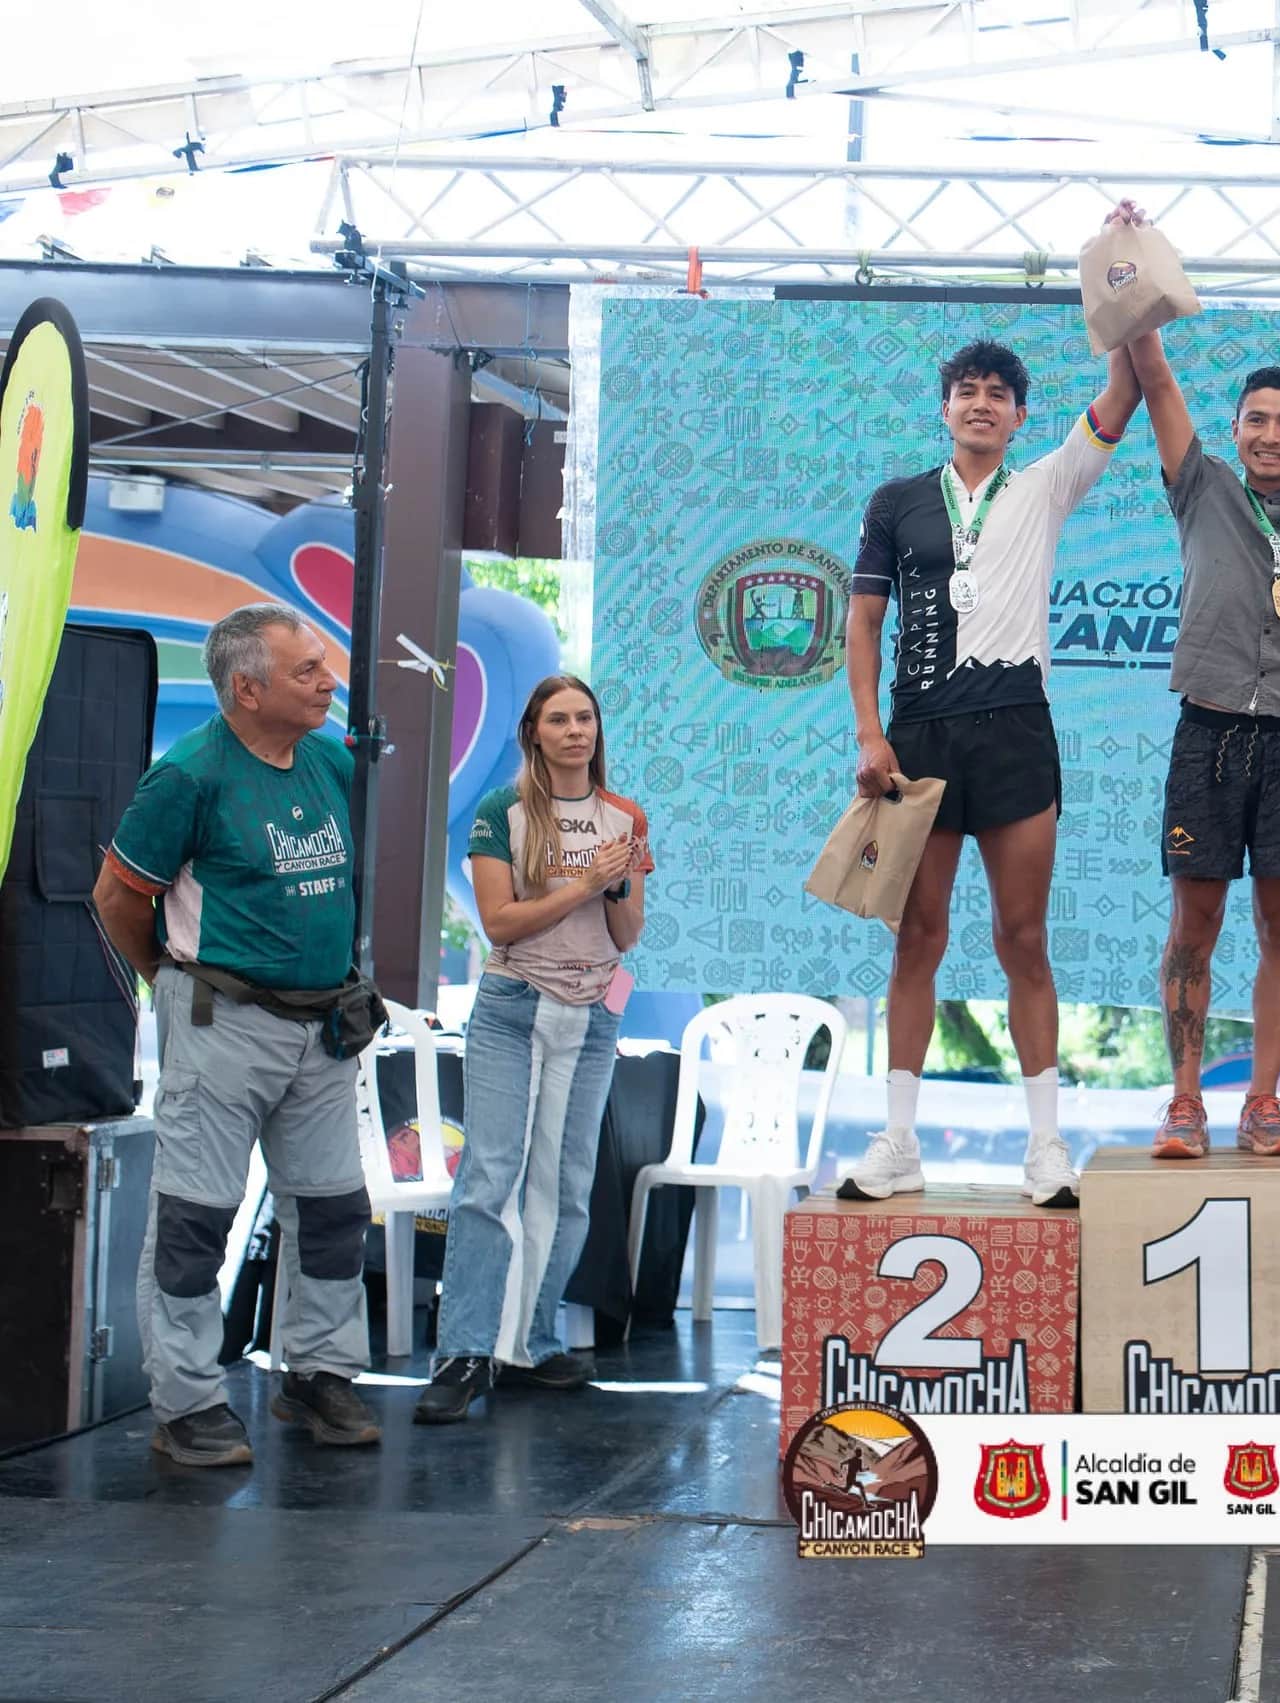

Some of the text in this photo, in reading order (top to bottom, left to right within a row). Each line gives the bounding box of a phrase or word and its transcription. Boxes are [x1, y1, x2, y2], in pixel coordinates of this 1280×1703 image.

[787, 543, 805, 556] DE
[904, 547, 923, 676] CAPITAL
[920, 588, 939, 690] RUNNING
[266, 814, 345, 861] CHICAMOCHA
[284, 854, 341, 871] CANYON RACE
[299, 877, 336, 896] STAFF
[878, 1234, 983, 1368] 2
[1144, 1198, 1251, 1373] 1
